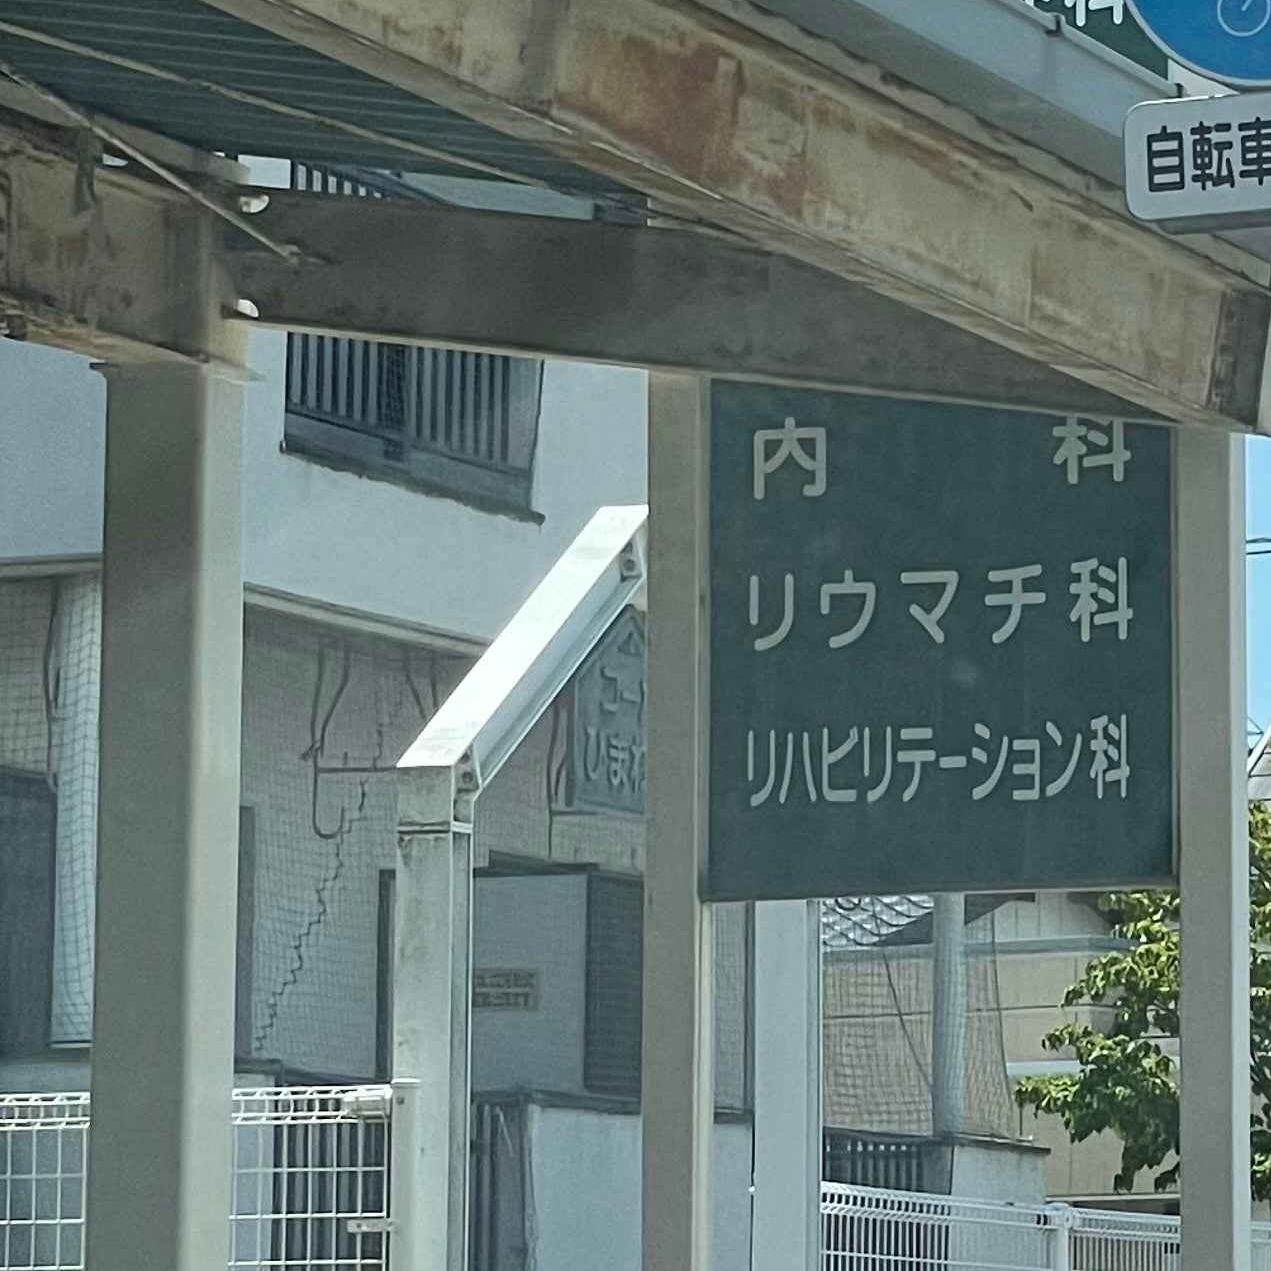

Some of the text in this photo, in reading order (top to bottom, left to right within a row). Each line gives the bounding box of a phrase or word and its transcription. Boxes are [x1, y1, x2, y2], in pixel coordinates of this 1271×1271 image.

[753, 415, 1132, 500] 内 科
[748, 556, 1134, 651] リウマチ科
[747, 714, 1131, 807] リハビリテーション科
